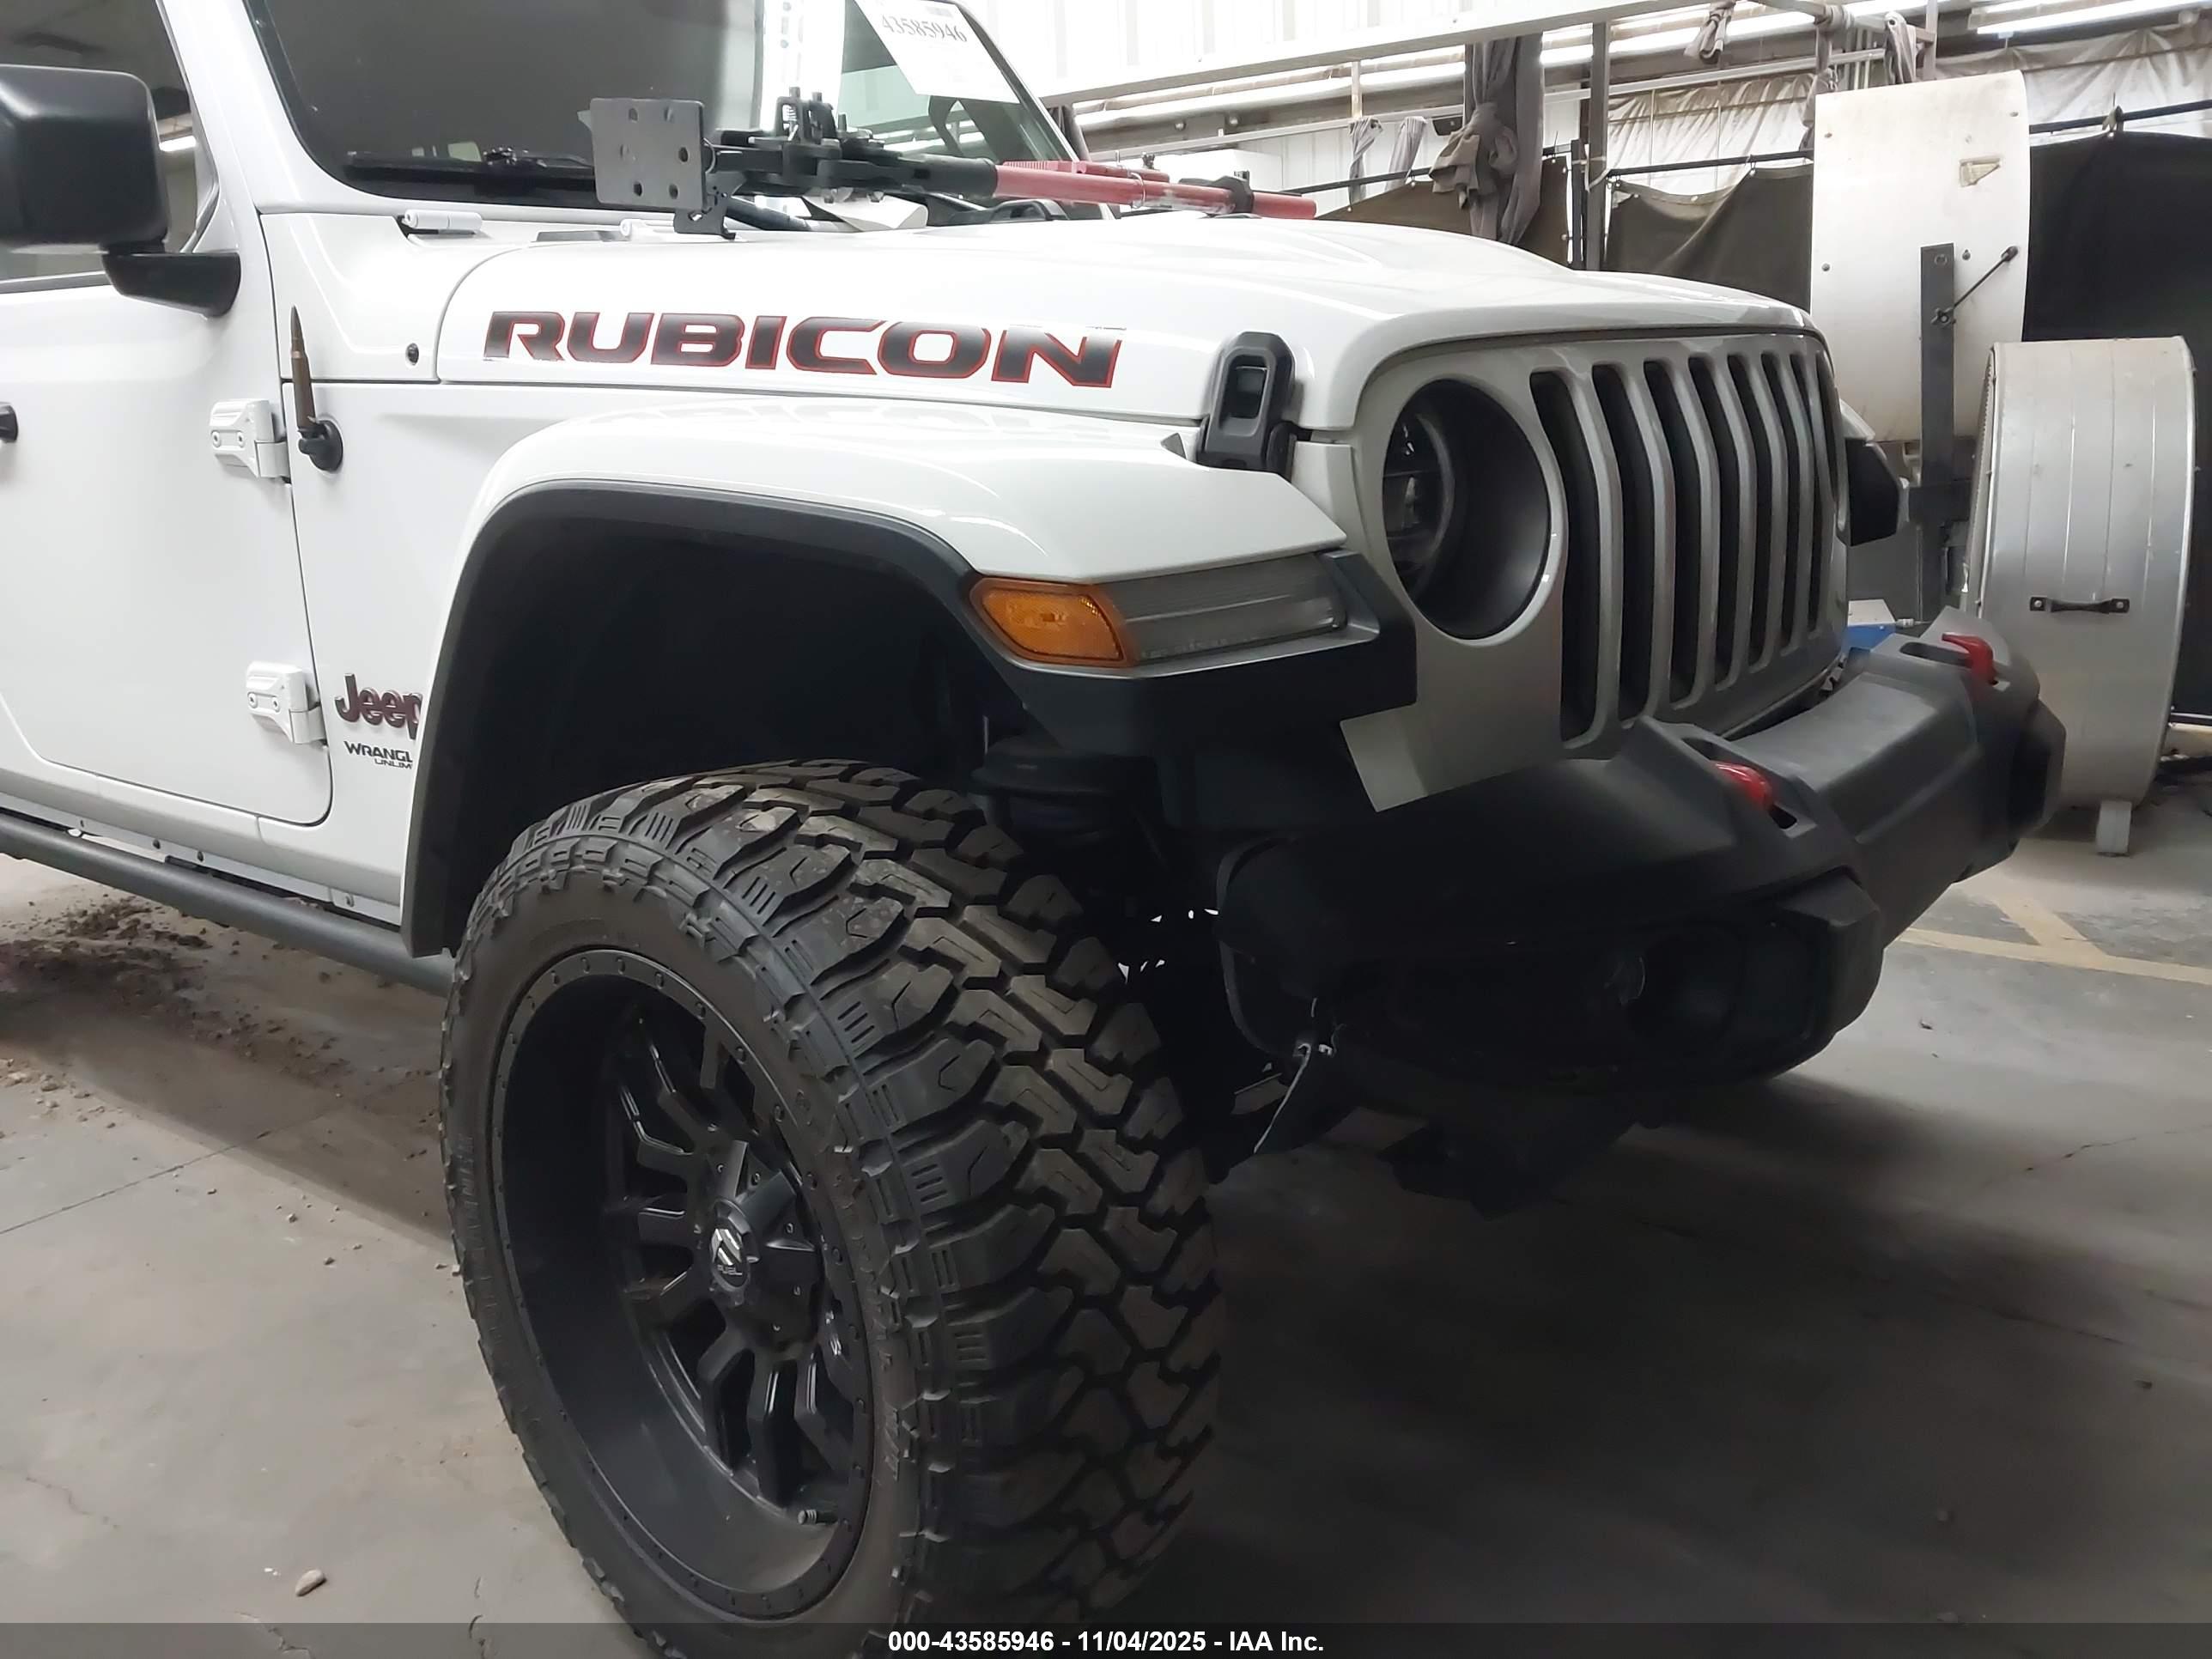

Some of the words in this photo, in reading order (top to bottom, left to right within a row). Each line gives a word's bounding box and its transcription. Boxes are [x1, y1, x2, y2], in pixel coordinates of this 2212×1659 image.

[881, 15, 968, 42] 43585946
[483, 310, 1125, 388] RUBICON
[334, 673, 423, 740] Jeep
